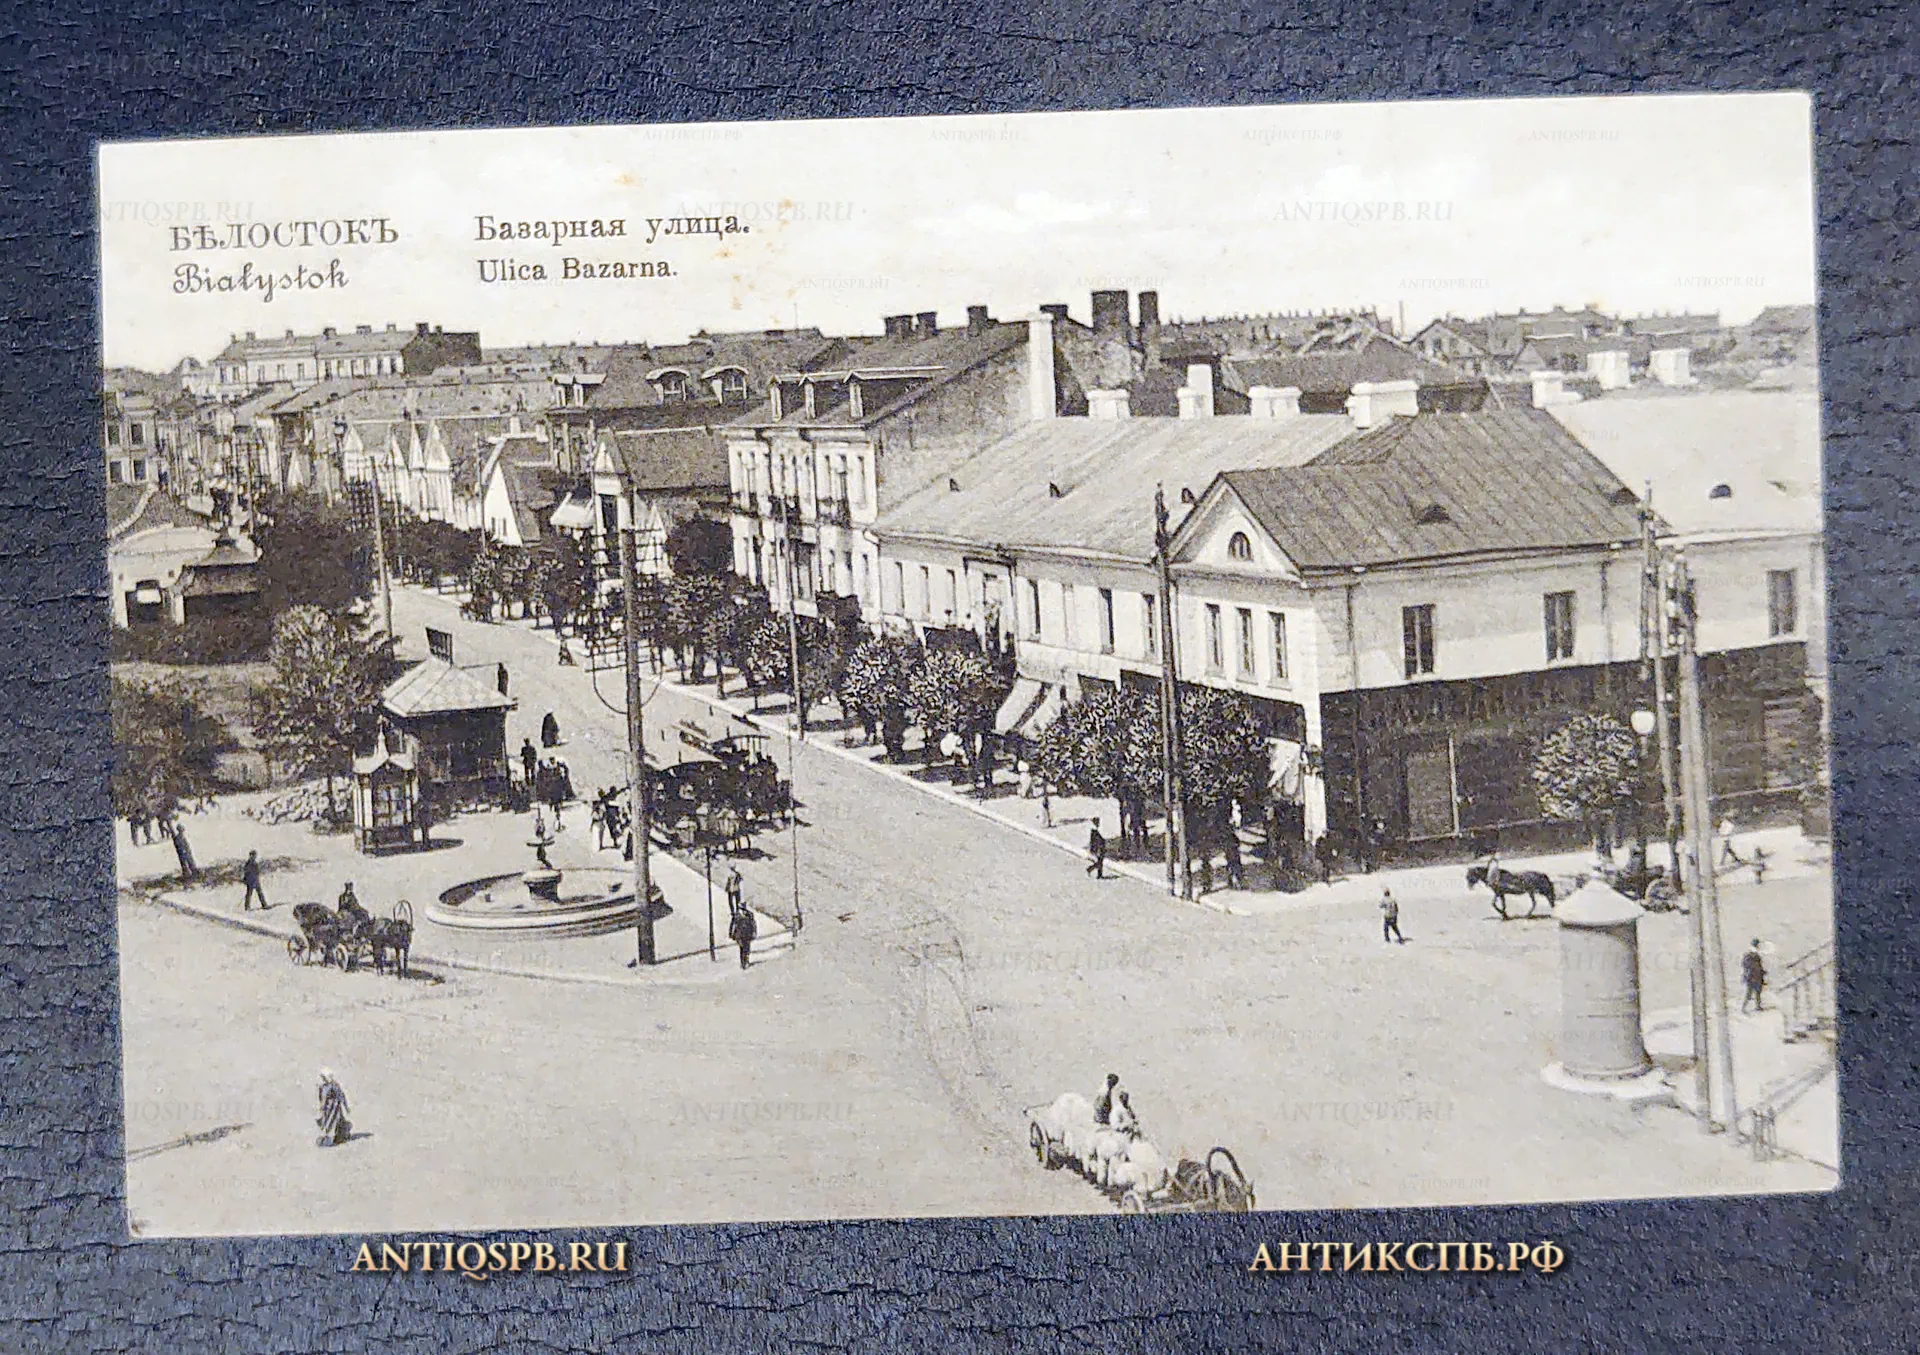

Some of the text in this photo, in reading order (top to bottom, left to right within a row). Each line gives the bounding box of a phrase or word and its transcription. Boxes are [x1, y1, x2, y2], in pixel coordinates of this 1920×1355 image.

[169, 218, 399, 252] БѢЛОСТОКЪ
[475, 215, 750, 246] Базарная улица.
[173, 258, 349, 303] Białystok
[477, 259, 547, 283] Ulica
[562, 257, 678, 280] Bazarna.
